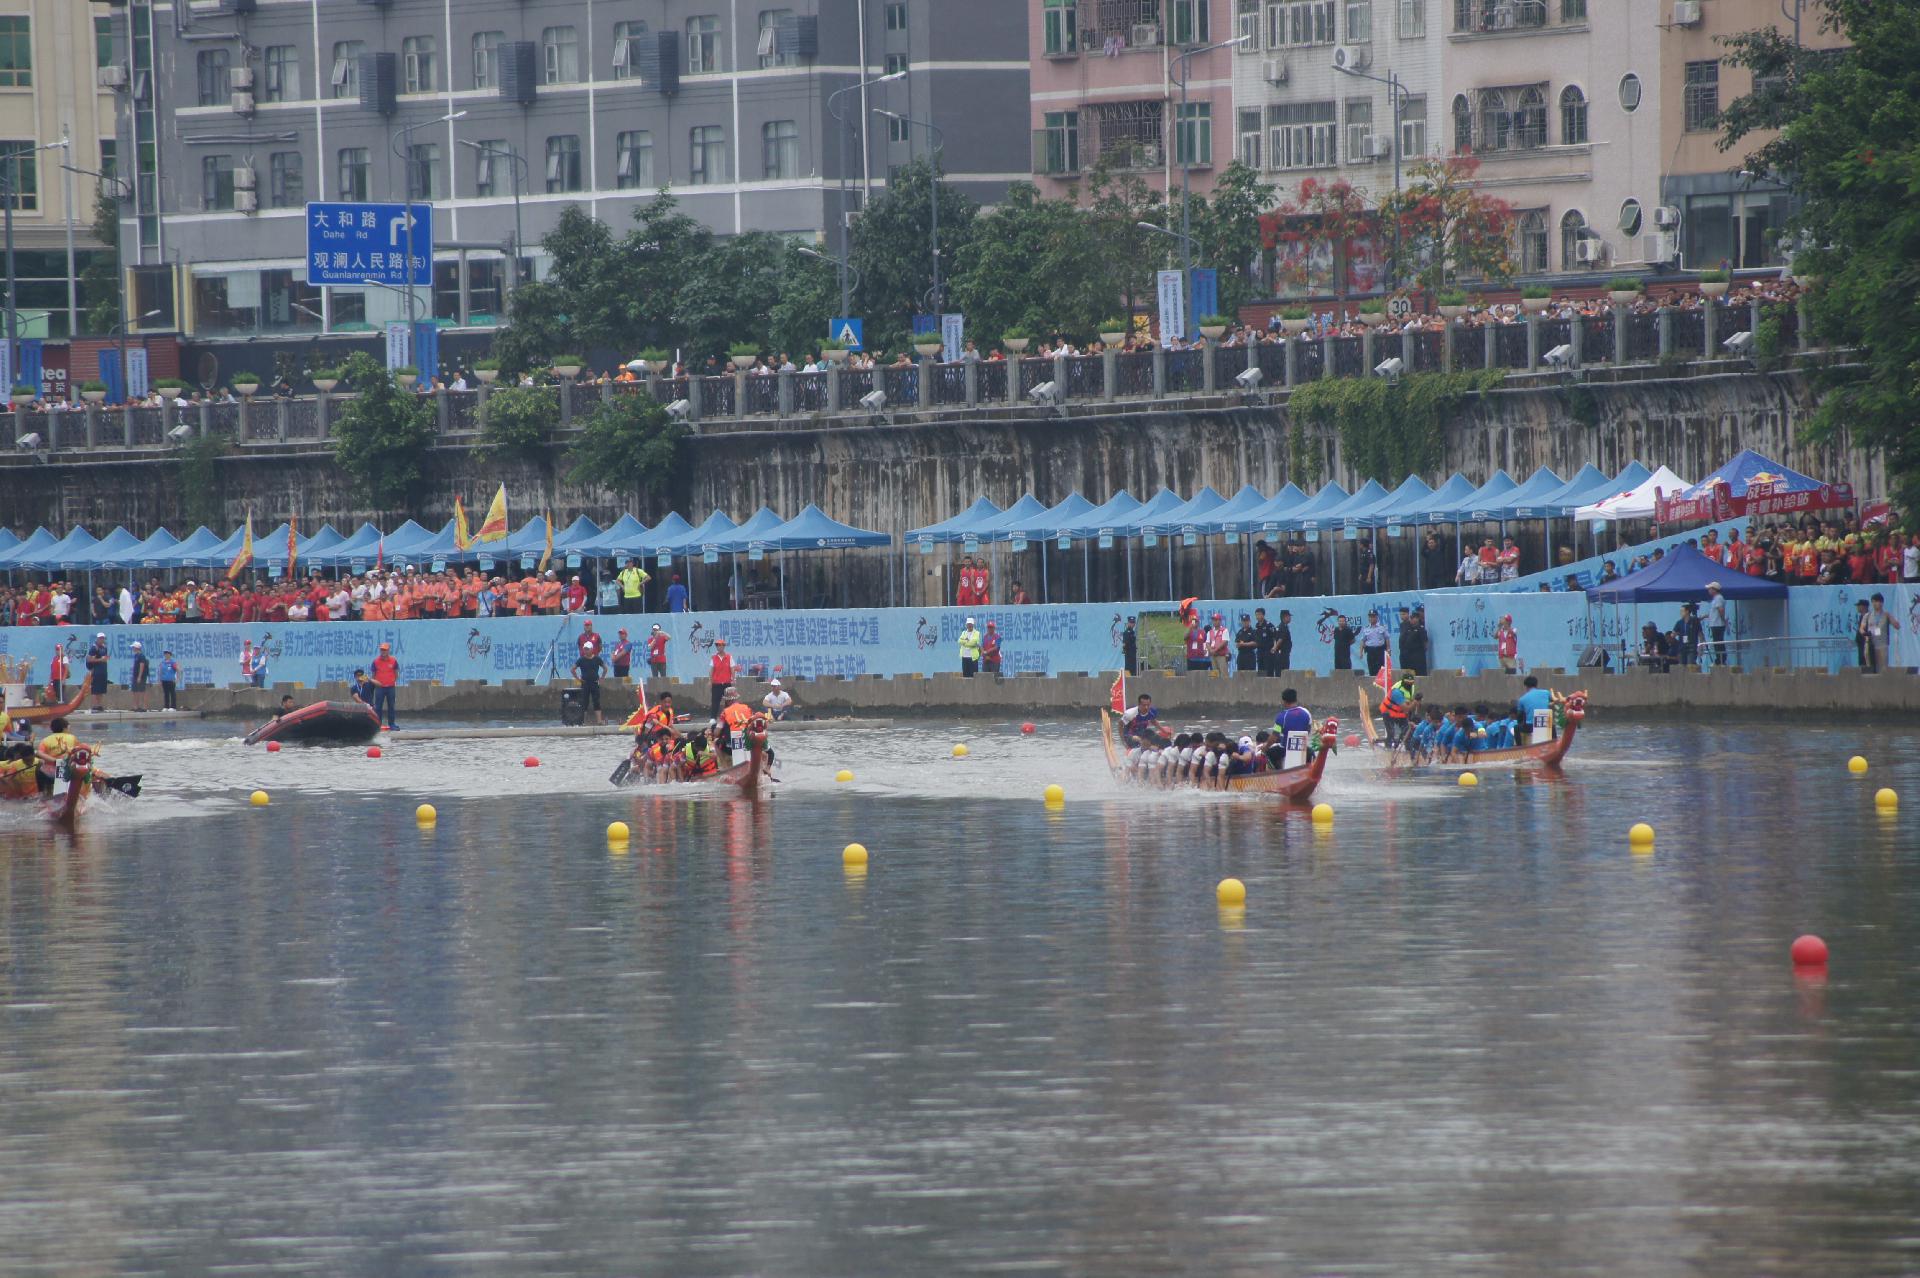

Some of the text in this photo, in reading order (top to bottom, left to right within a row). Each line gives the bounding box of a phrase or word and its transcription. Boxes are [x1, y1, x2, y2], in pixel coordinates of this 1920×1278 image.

[314, 211, 376, 228] 大和路
[323, 231, 368, 239] Dahe Rd
[322, 270, 386, 279] Guanlanrenmin
[391, 270, 402, 279] Rd
[1392, 301, 1408, 315] 30
[1747, 482, 1775, 500] 战马
[1746, 491, 1810, 516] 能量补给站
